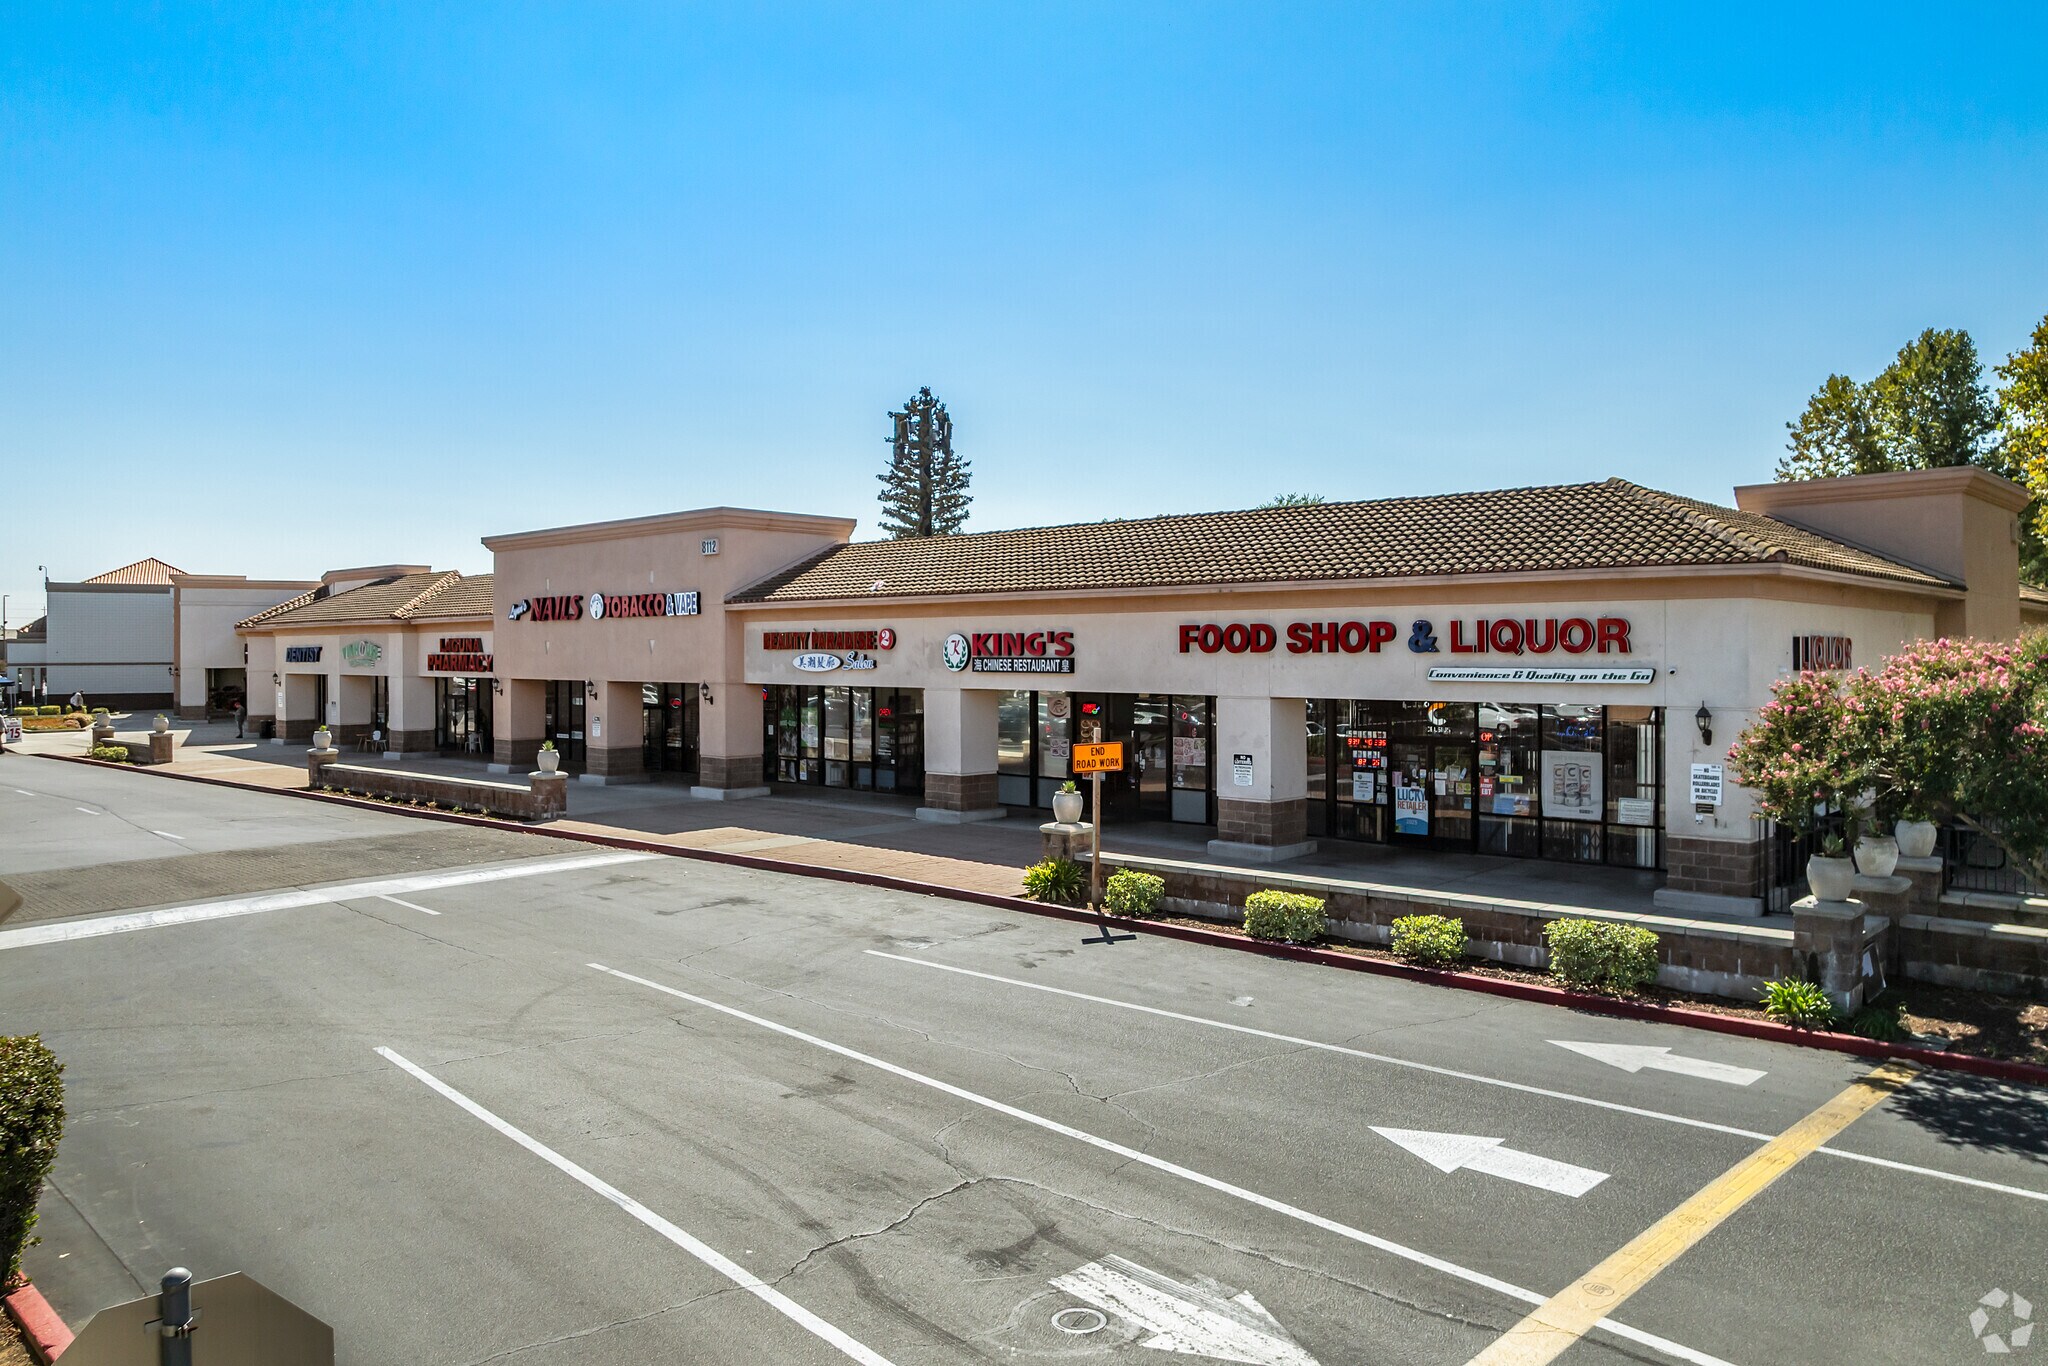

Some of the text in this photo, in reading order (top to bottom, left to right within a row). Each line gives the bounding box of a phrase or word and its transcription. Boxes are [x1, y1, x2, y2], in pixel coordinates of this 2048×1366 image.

[702, 540, 716, 553] 8112
[530, 595, 583, 621] NAILS
[605, 592, 700, 617] TOBACCO & VAPE
[763, 632, 810, 650] BEAUTY
[811, 631, 878, 650] PARADISE
[1179, 617, 1632, 655] FOOD SHOP & LIQUOR
[440, 638, 484, 652] LAGUNA
[972, 631, 1075, 656] KING'S
[286, 647, 323, 662] DENTIST
[1793, 635, 1853, 671] LIQUOR
[428, 654, 494, 672] PHARMACY
[842, 650, 877, 671] Salon
[983, 659, 1060, 672] CHINESE RESTAURANT
[1428, 669, 1511, 679] Convenience
[1525, 669, 1576, 682] Quality
[1602, 670, 1627, 680] the
[1630, 669, 1651, 680] Go
[10, 727, 21, 739] 15
[1091, 747, 1105, 756] END
[1076, 758, 1120, 769] ROAD WORK
[1397, 788, 1426, 802] LUCKY
[1481, 788, 1492, 796] EBT
[1695, 794, 1717, 802] PERMITTED
[1701, 787, 1719, 795] BICYCLES
[1397, 801, 1427, 812] RETAILER
